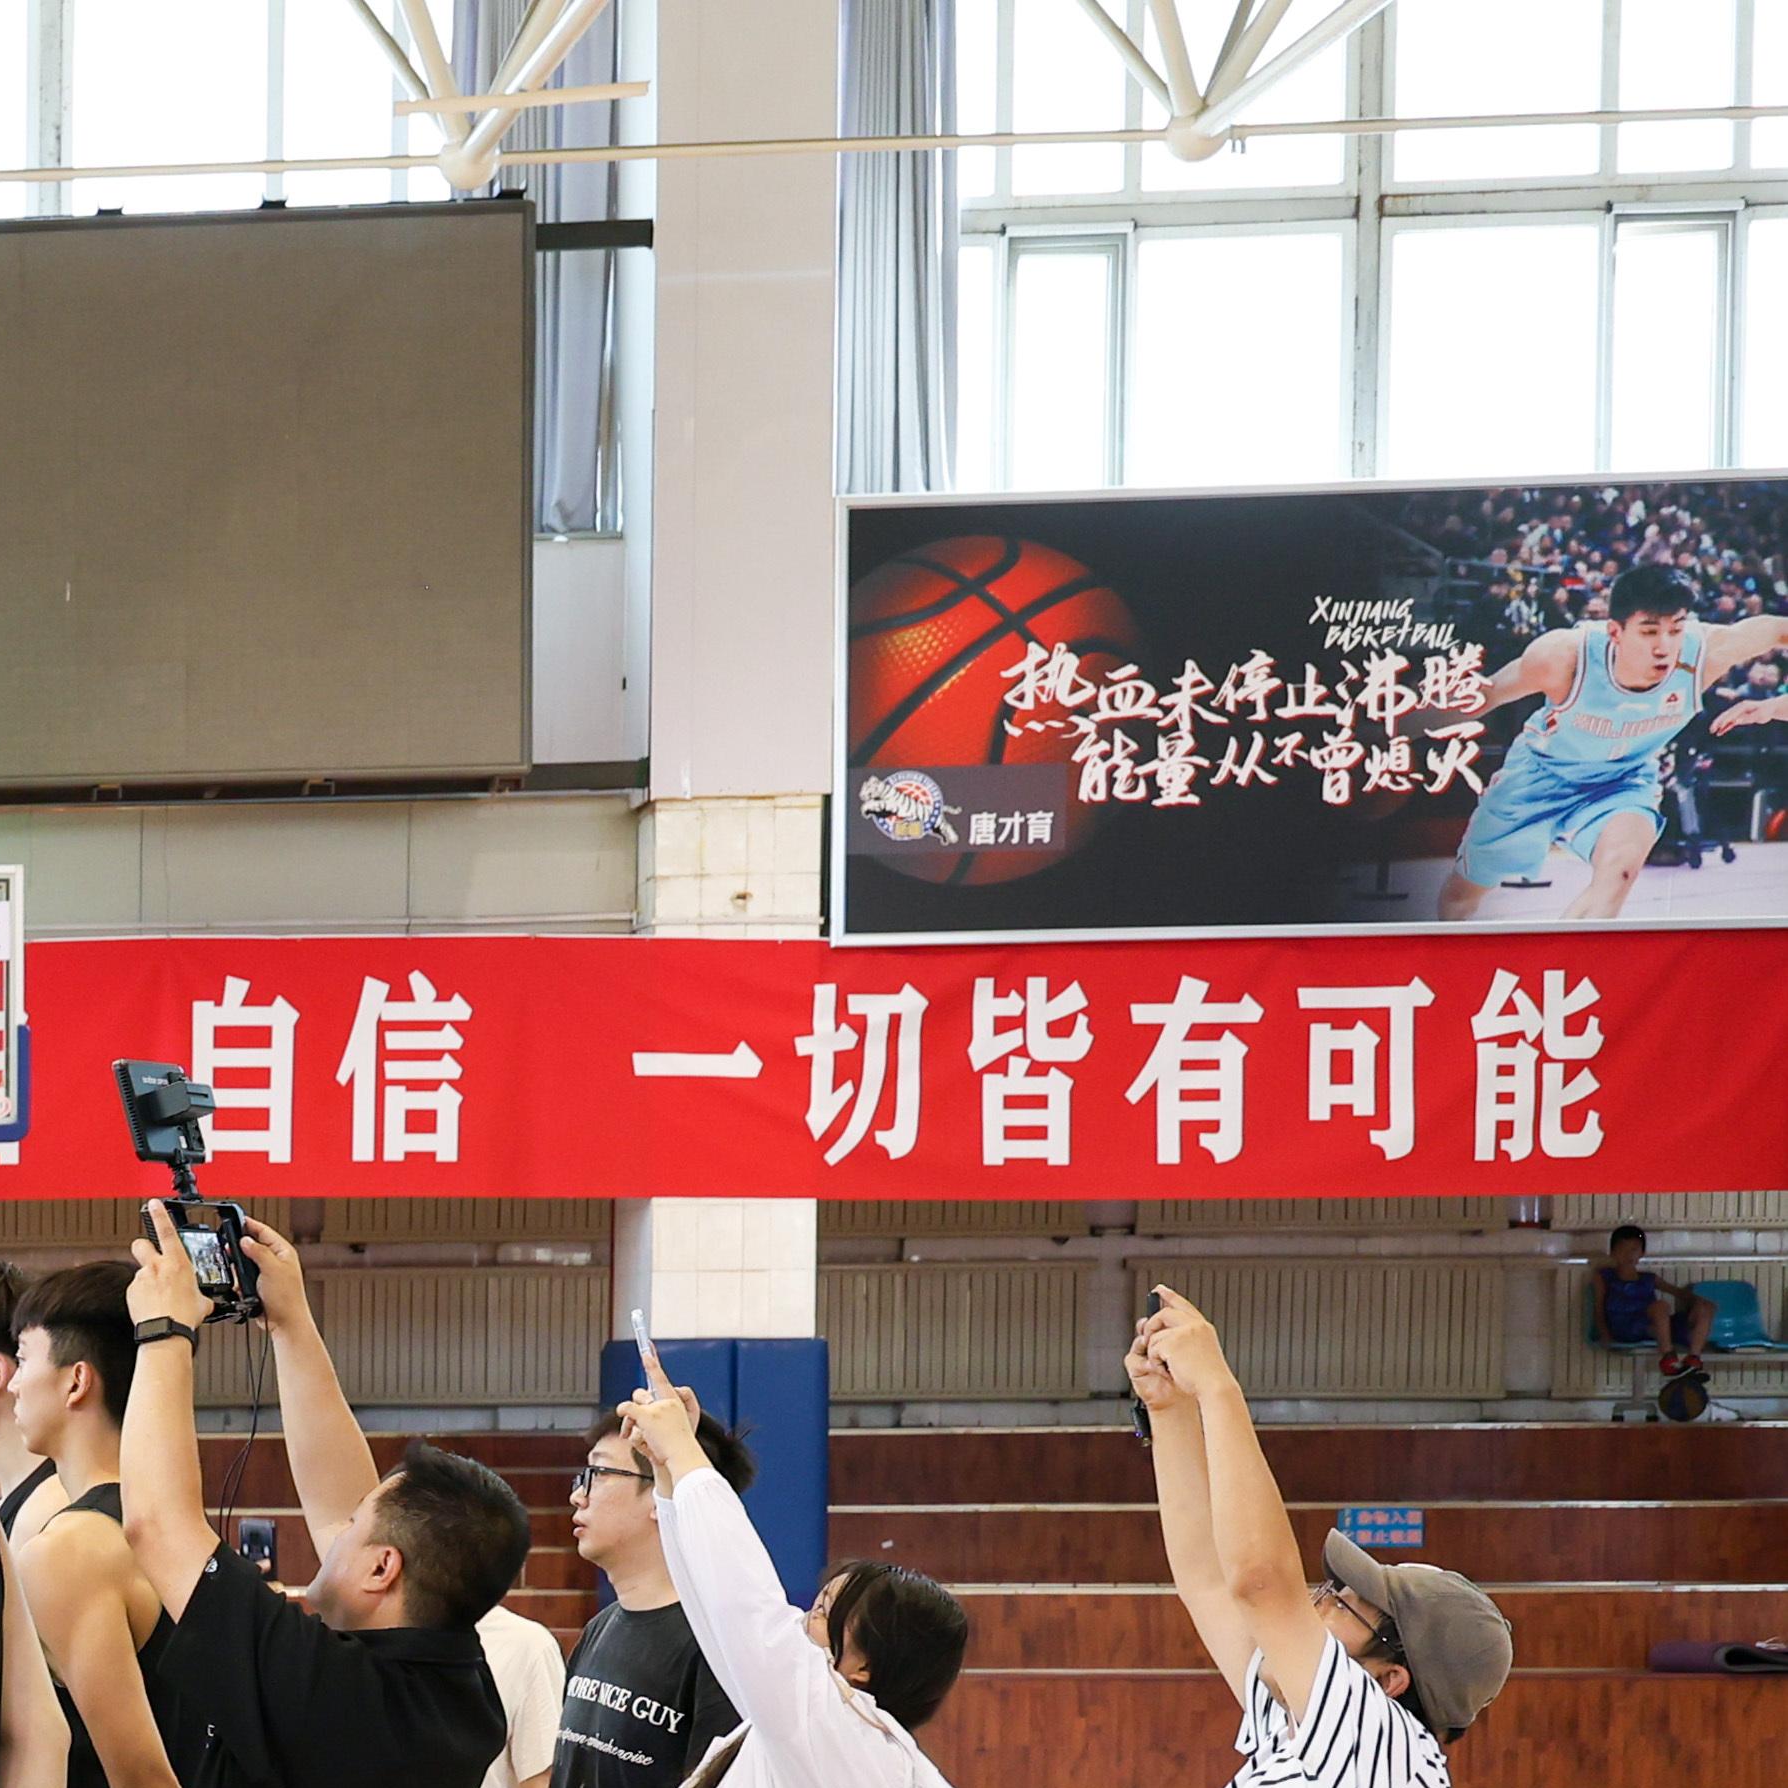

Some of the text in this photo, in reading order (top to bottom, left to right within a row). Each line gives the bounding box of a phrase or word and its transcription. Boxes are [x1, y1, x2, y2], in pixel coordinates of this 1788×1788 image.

[1309, 595, 1415, 630] XINJIANG
[1325, 617, 1461, 650] BASKETBALL
[998, 640, 1493, 738] 热血未停止沸腾
[1070, 721, 1486, 807] 能量从不曾熄灭
[968, 811, 1055, 845] 唐才育
[192, 969, 473, 1164] 自信
[631, 968, 1606, 1166] 一切皆有可能
[632, 1696, 685, 1734] GUY
